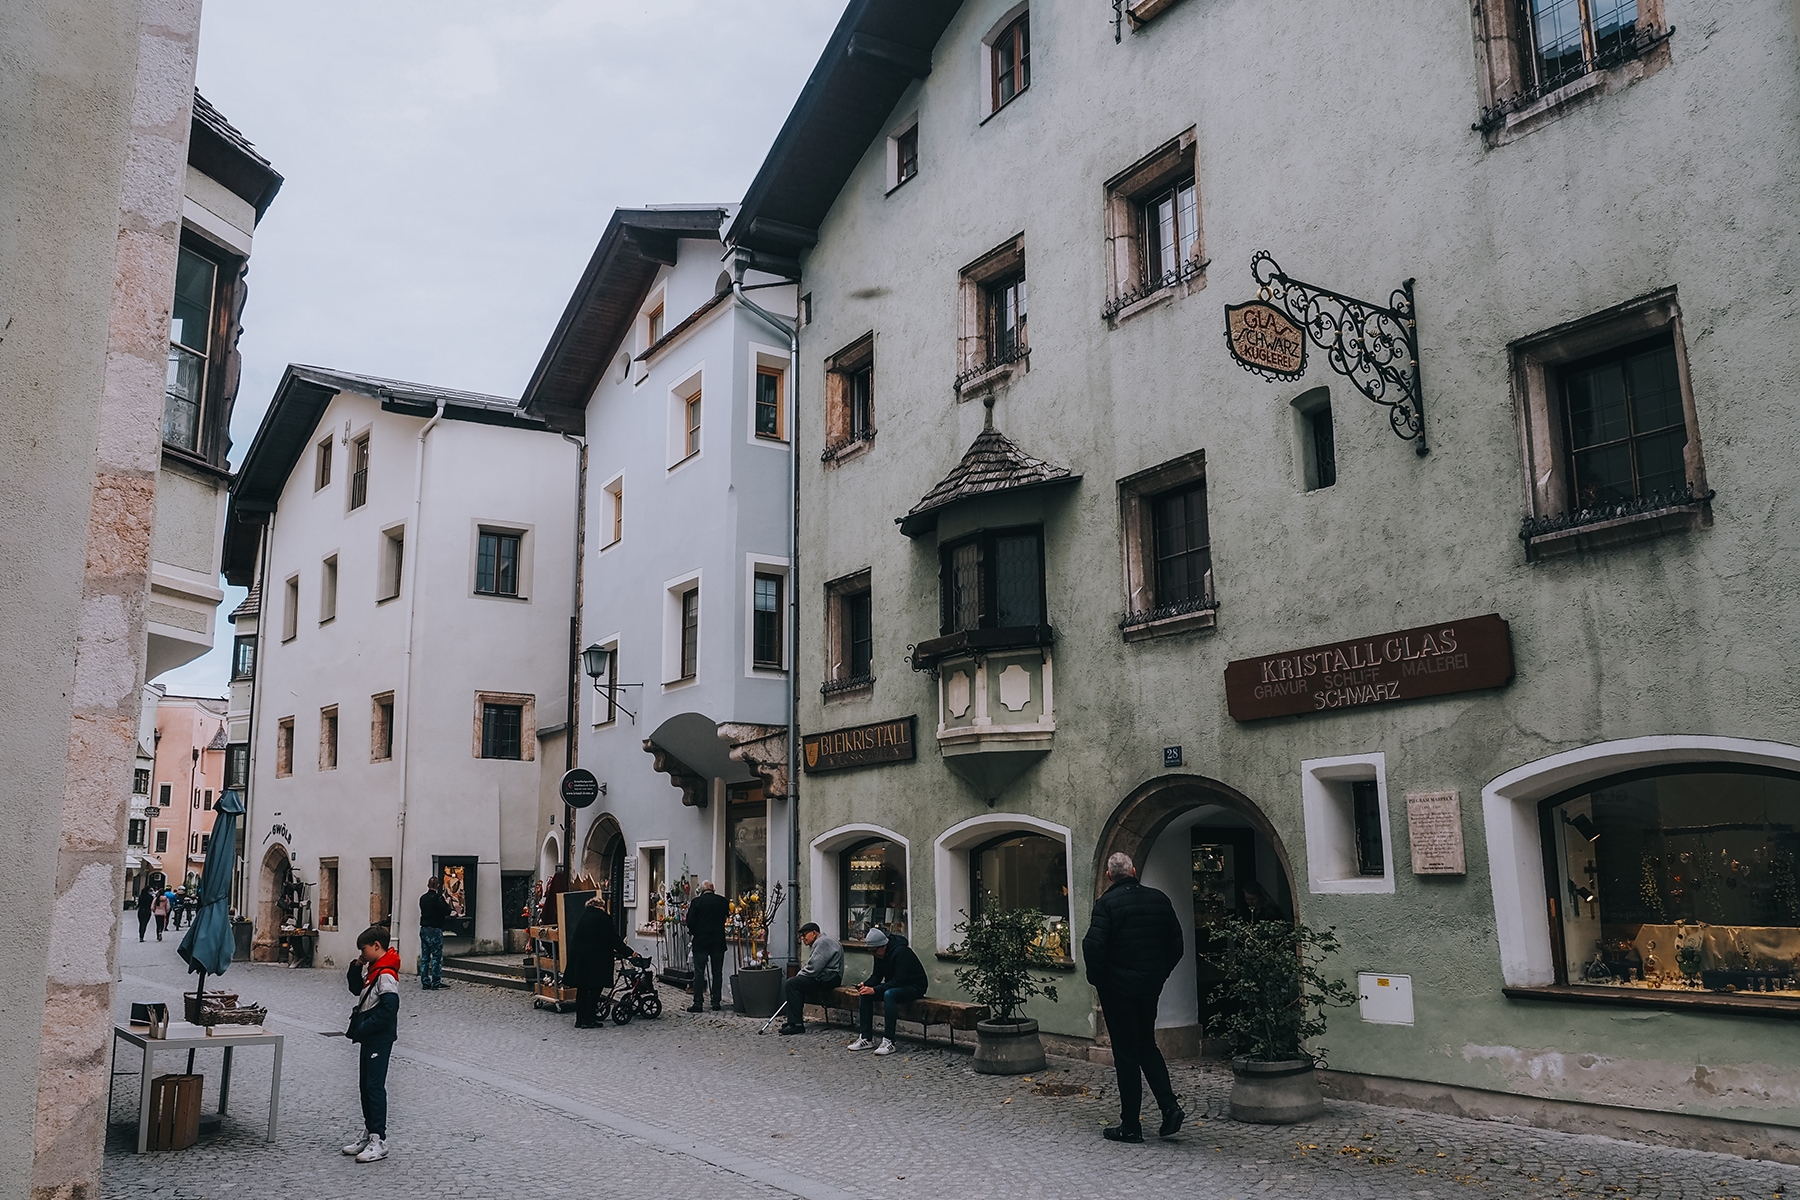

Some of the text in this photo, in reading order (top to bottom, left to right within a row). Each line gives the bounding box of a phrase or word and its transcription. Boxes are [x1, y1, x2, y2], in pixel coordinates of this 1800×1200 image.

[1234, 328, 1299, 358] SCHWARZ
[1244, 344, 1291, 368] KUGLEREI
[1254, 653, 1469, 700] GRAVUR SCHLIFF MALEREI
[1314, 680, 1400, 710] SCHWARZ
[820, 723, 909, 756] BLEIKRISTALL
[1166, 747, 1179, 759] 28
